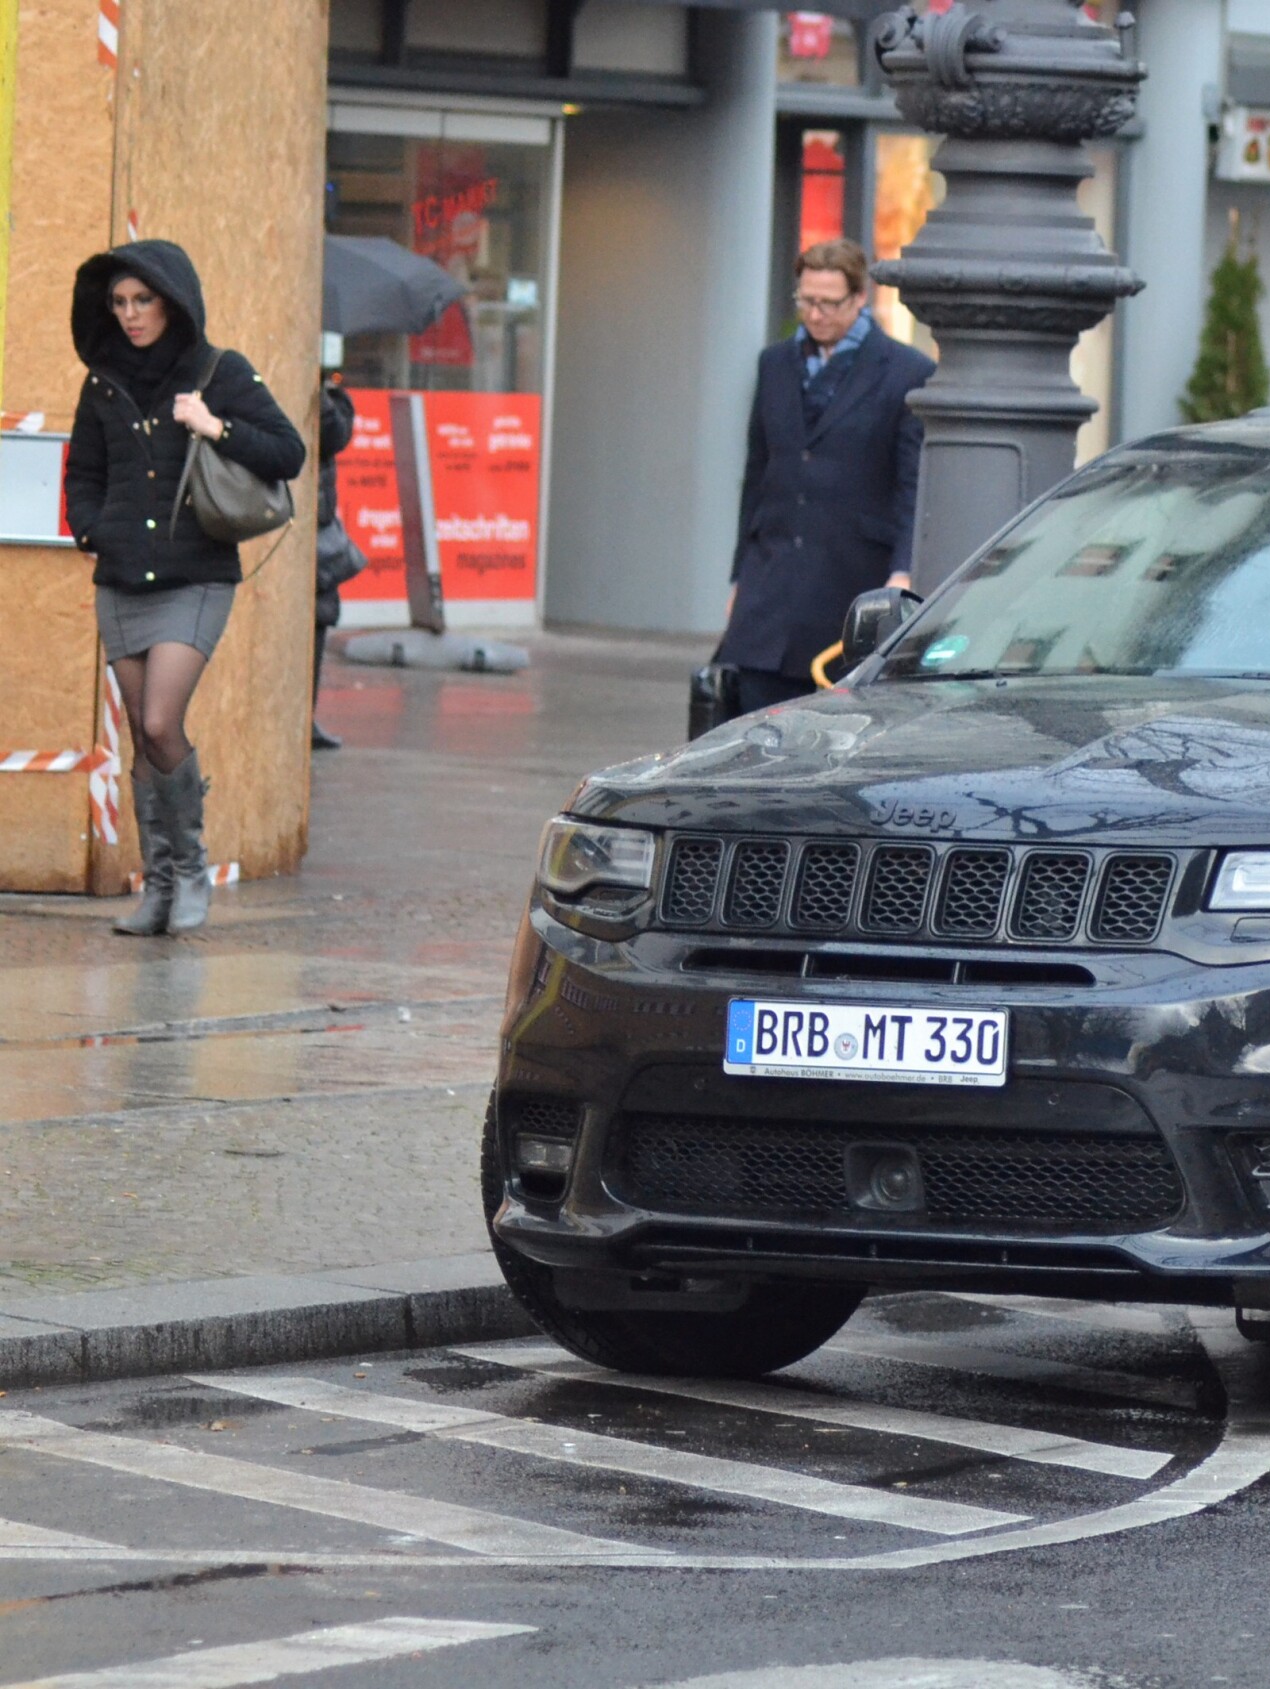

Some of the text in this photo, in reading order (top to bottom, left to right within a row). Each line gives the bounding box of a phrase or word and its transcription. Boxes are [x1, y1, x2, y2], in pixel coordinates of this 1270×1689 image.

[870, 800, 957, 833] Jeep
[736, 1039, 746, 1053] D
[756, 1009, 999, 1065] BRB MT 330
[764, 1067, 799, 1076] Autohaus
[960, 1075, 978, 1084] Jeep
